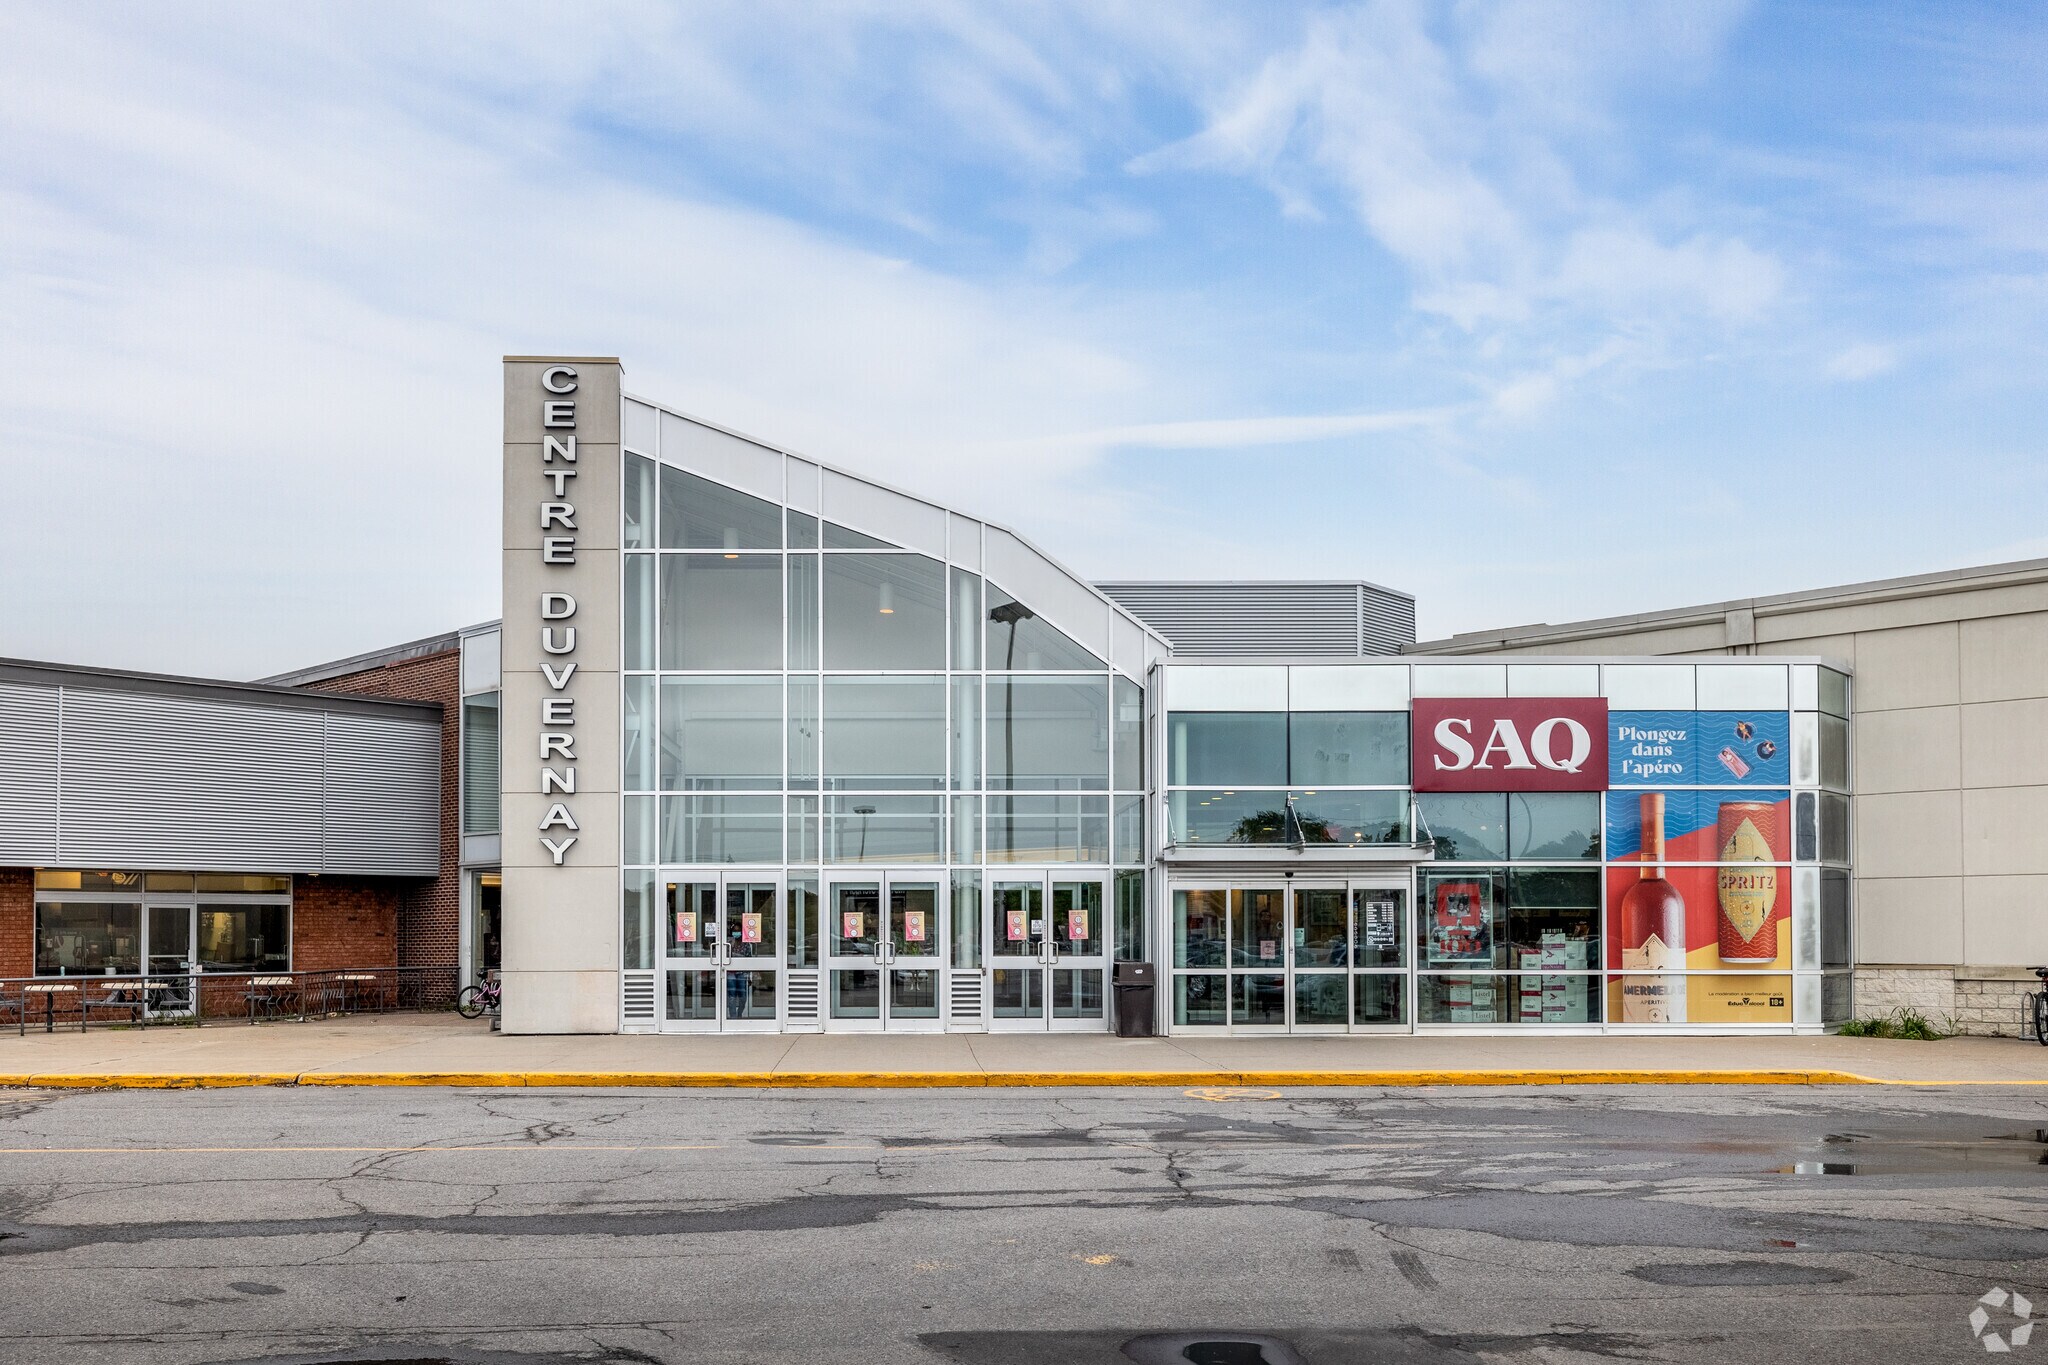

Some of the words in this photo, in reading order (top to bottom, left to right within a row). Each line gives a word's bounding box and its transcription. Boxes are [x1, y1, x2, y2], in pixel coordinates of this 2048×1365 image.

[540, 366, 578, 566] CENTRE
[538, 592, 579, 866] DUVERNAY
[1618, 726, 1687, 745] Plongez
[1433, 717, 1591, 774] SAQ
[1631, 742, 1673, 756] dans
[1622, 759, 1683, 778] l'apéro
[1719, 874, 1774, 890] SPRITZ
[1770, 998, 1783, 1006] 18+
